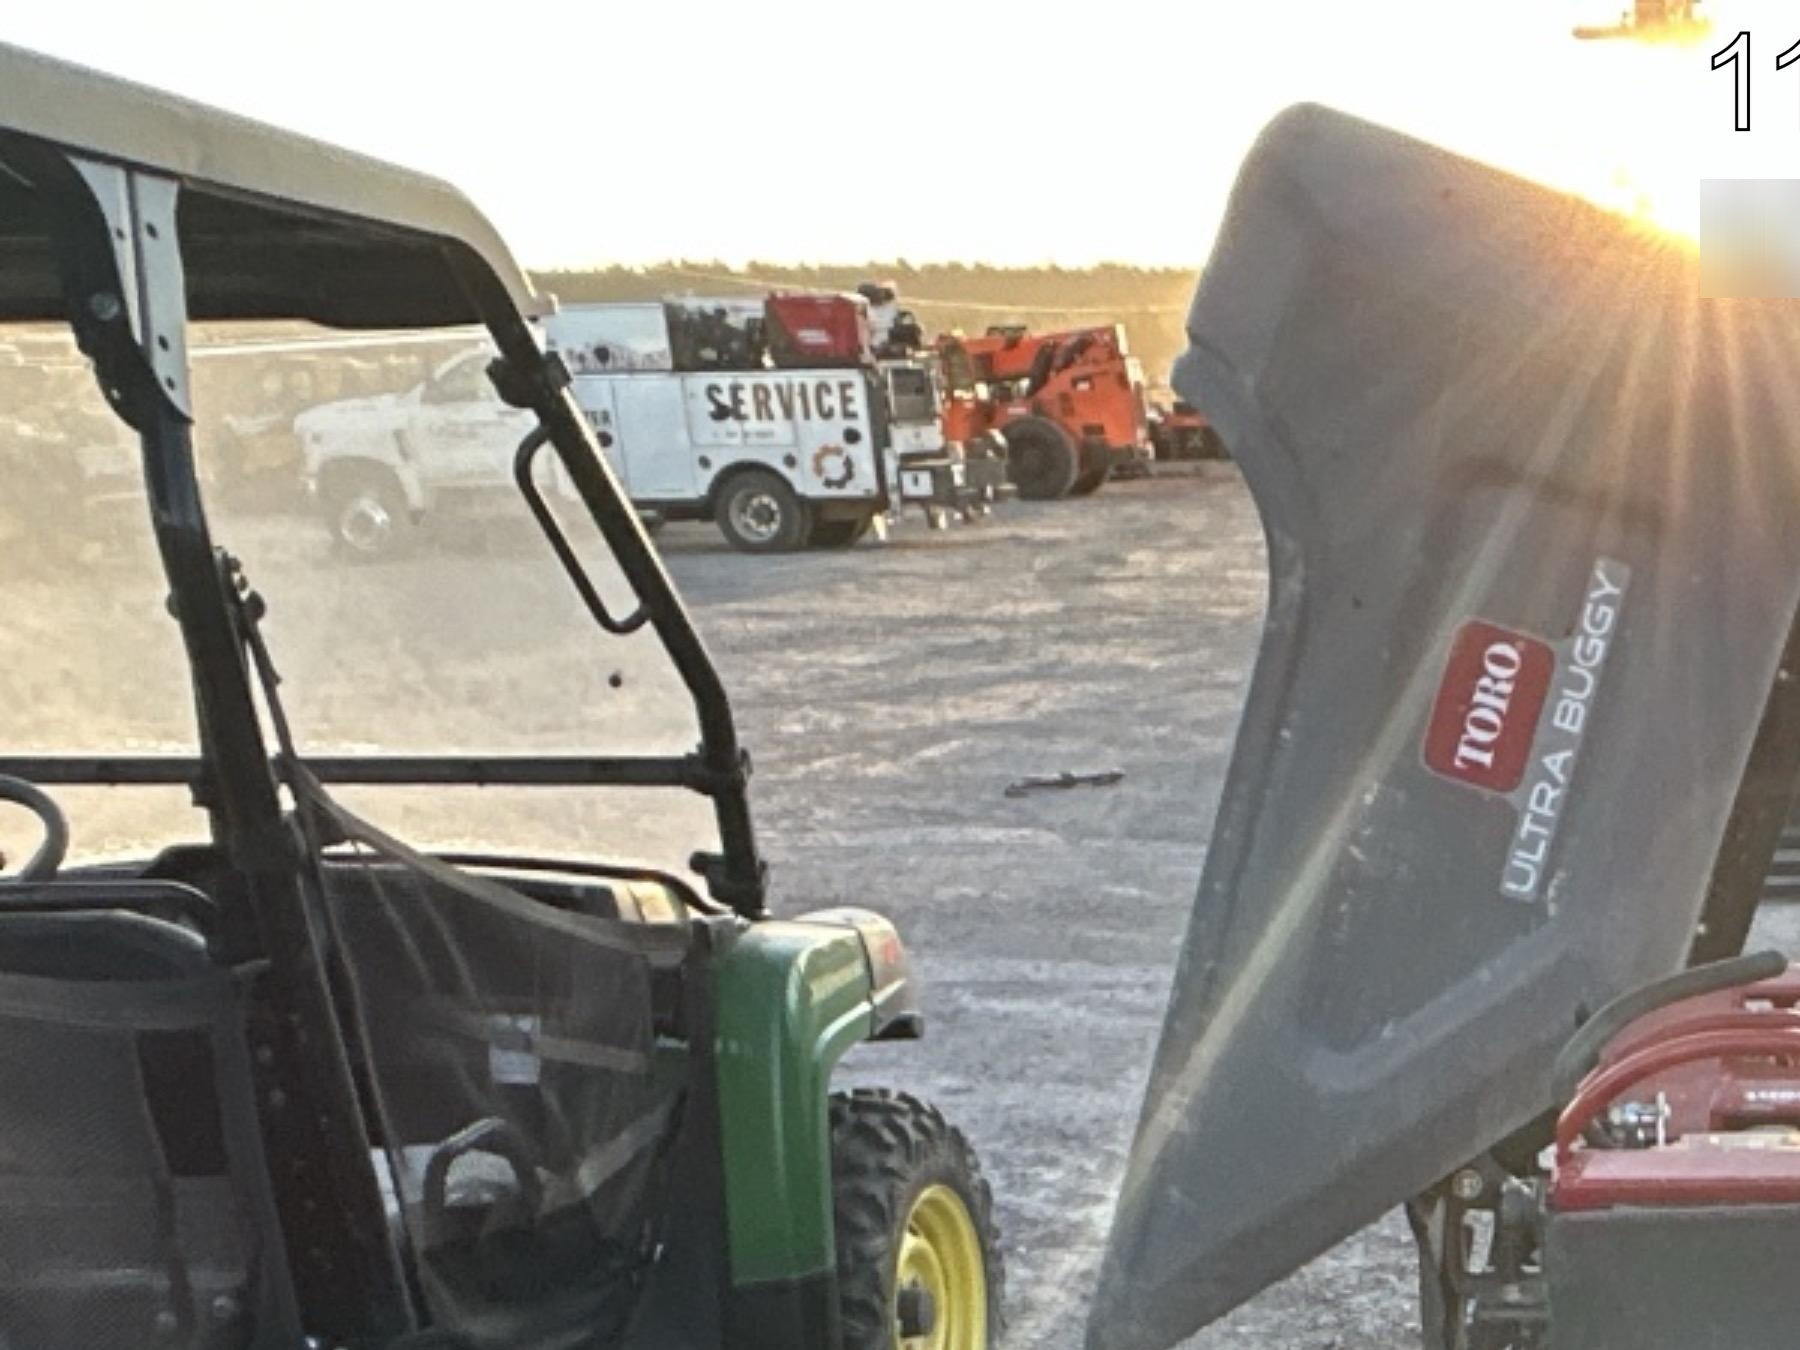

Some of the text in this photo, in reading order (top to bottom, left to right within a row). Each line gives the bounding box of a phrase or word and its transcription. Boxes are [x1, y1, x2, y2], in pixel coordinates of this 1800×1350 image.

[706, 379, 860, 422] SERVICE
[1454, 641, 1523, 770] TORO
[1505, 568, 1623, 893] ULTRA BUGGY
